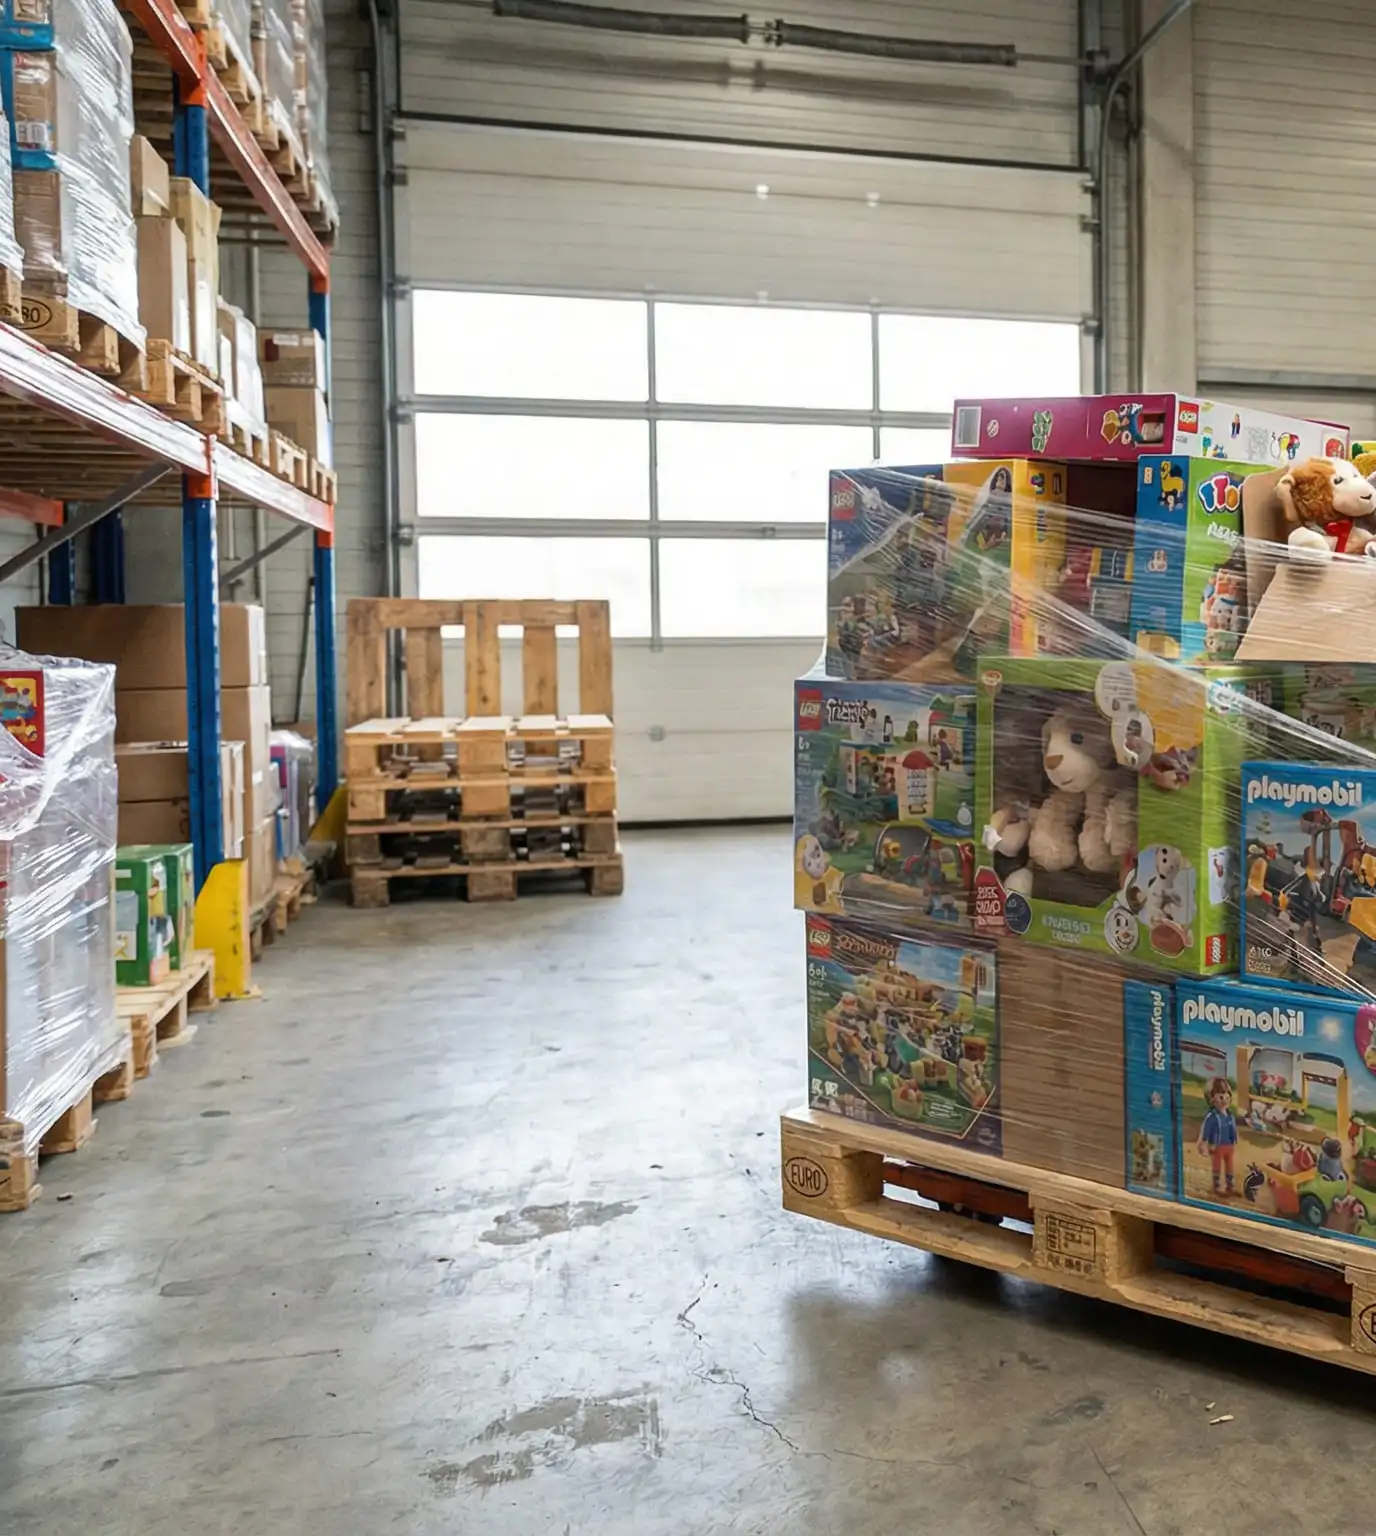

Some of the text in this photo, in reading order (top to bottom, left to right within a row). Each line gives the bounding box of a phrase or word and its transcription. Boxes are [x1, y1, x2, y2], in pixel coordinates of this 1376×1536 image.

[1247, 775, 1363, 808] playmobil
[1150, 990, 1165, 1071] playmobil
[1182, 995, 1304, 1037] playmobil
[791, 1164, 820, 1191] EURO
